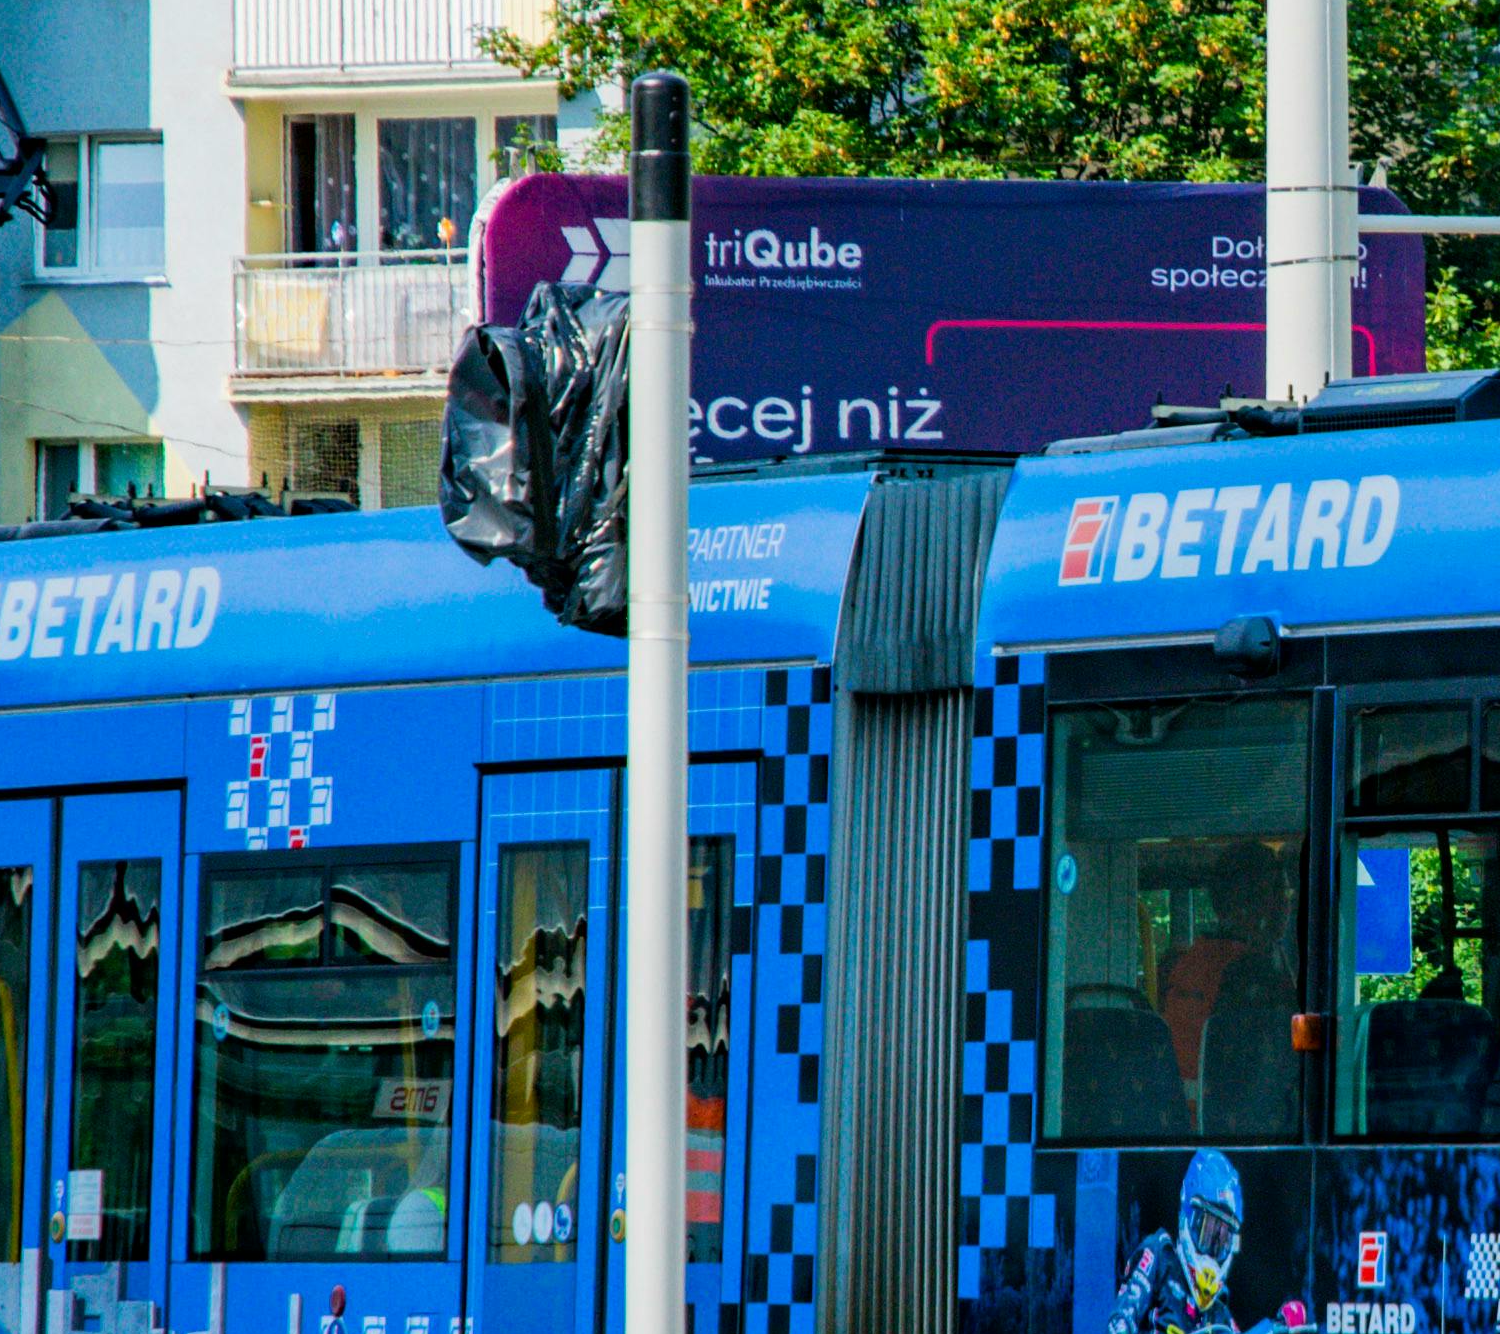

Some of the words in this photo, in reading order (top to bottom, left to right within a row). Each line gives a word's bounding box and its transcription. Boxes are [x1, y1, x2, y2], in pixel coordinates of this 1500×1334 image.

[705, 227, 862, 268] triQube
[705, 274, 756, 288] Inkubator
[759, 275, 862, 292] Przedsiębiorczości
[839, 385, 943, 441] niż
[1113, 475, 1399, 582] BETARD
[689, 578, 772, 612] NICTWIE
[1326, 1302, 1416, 1334] BETARD
